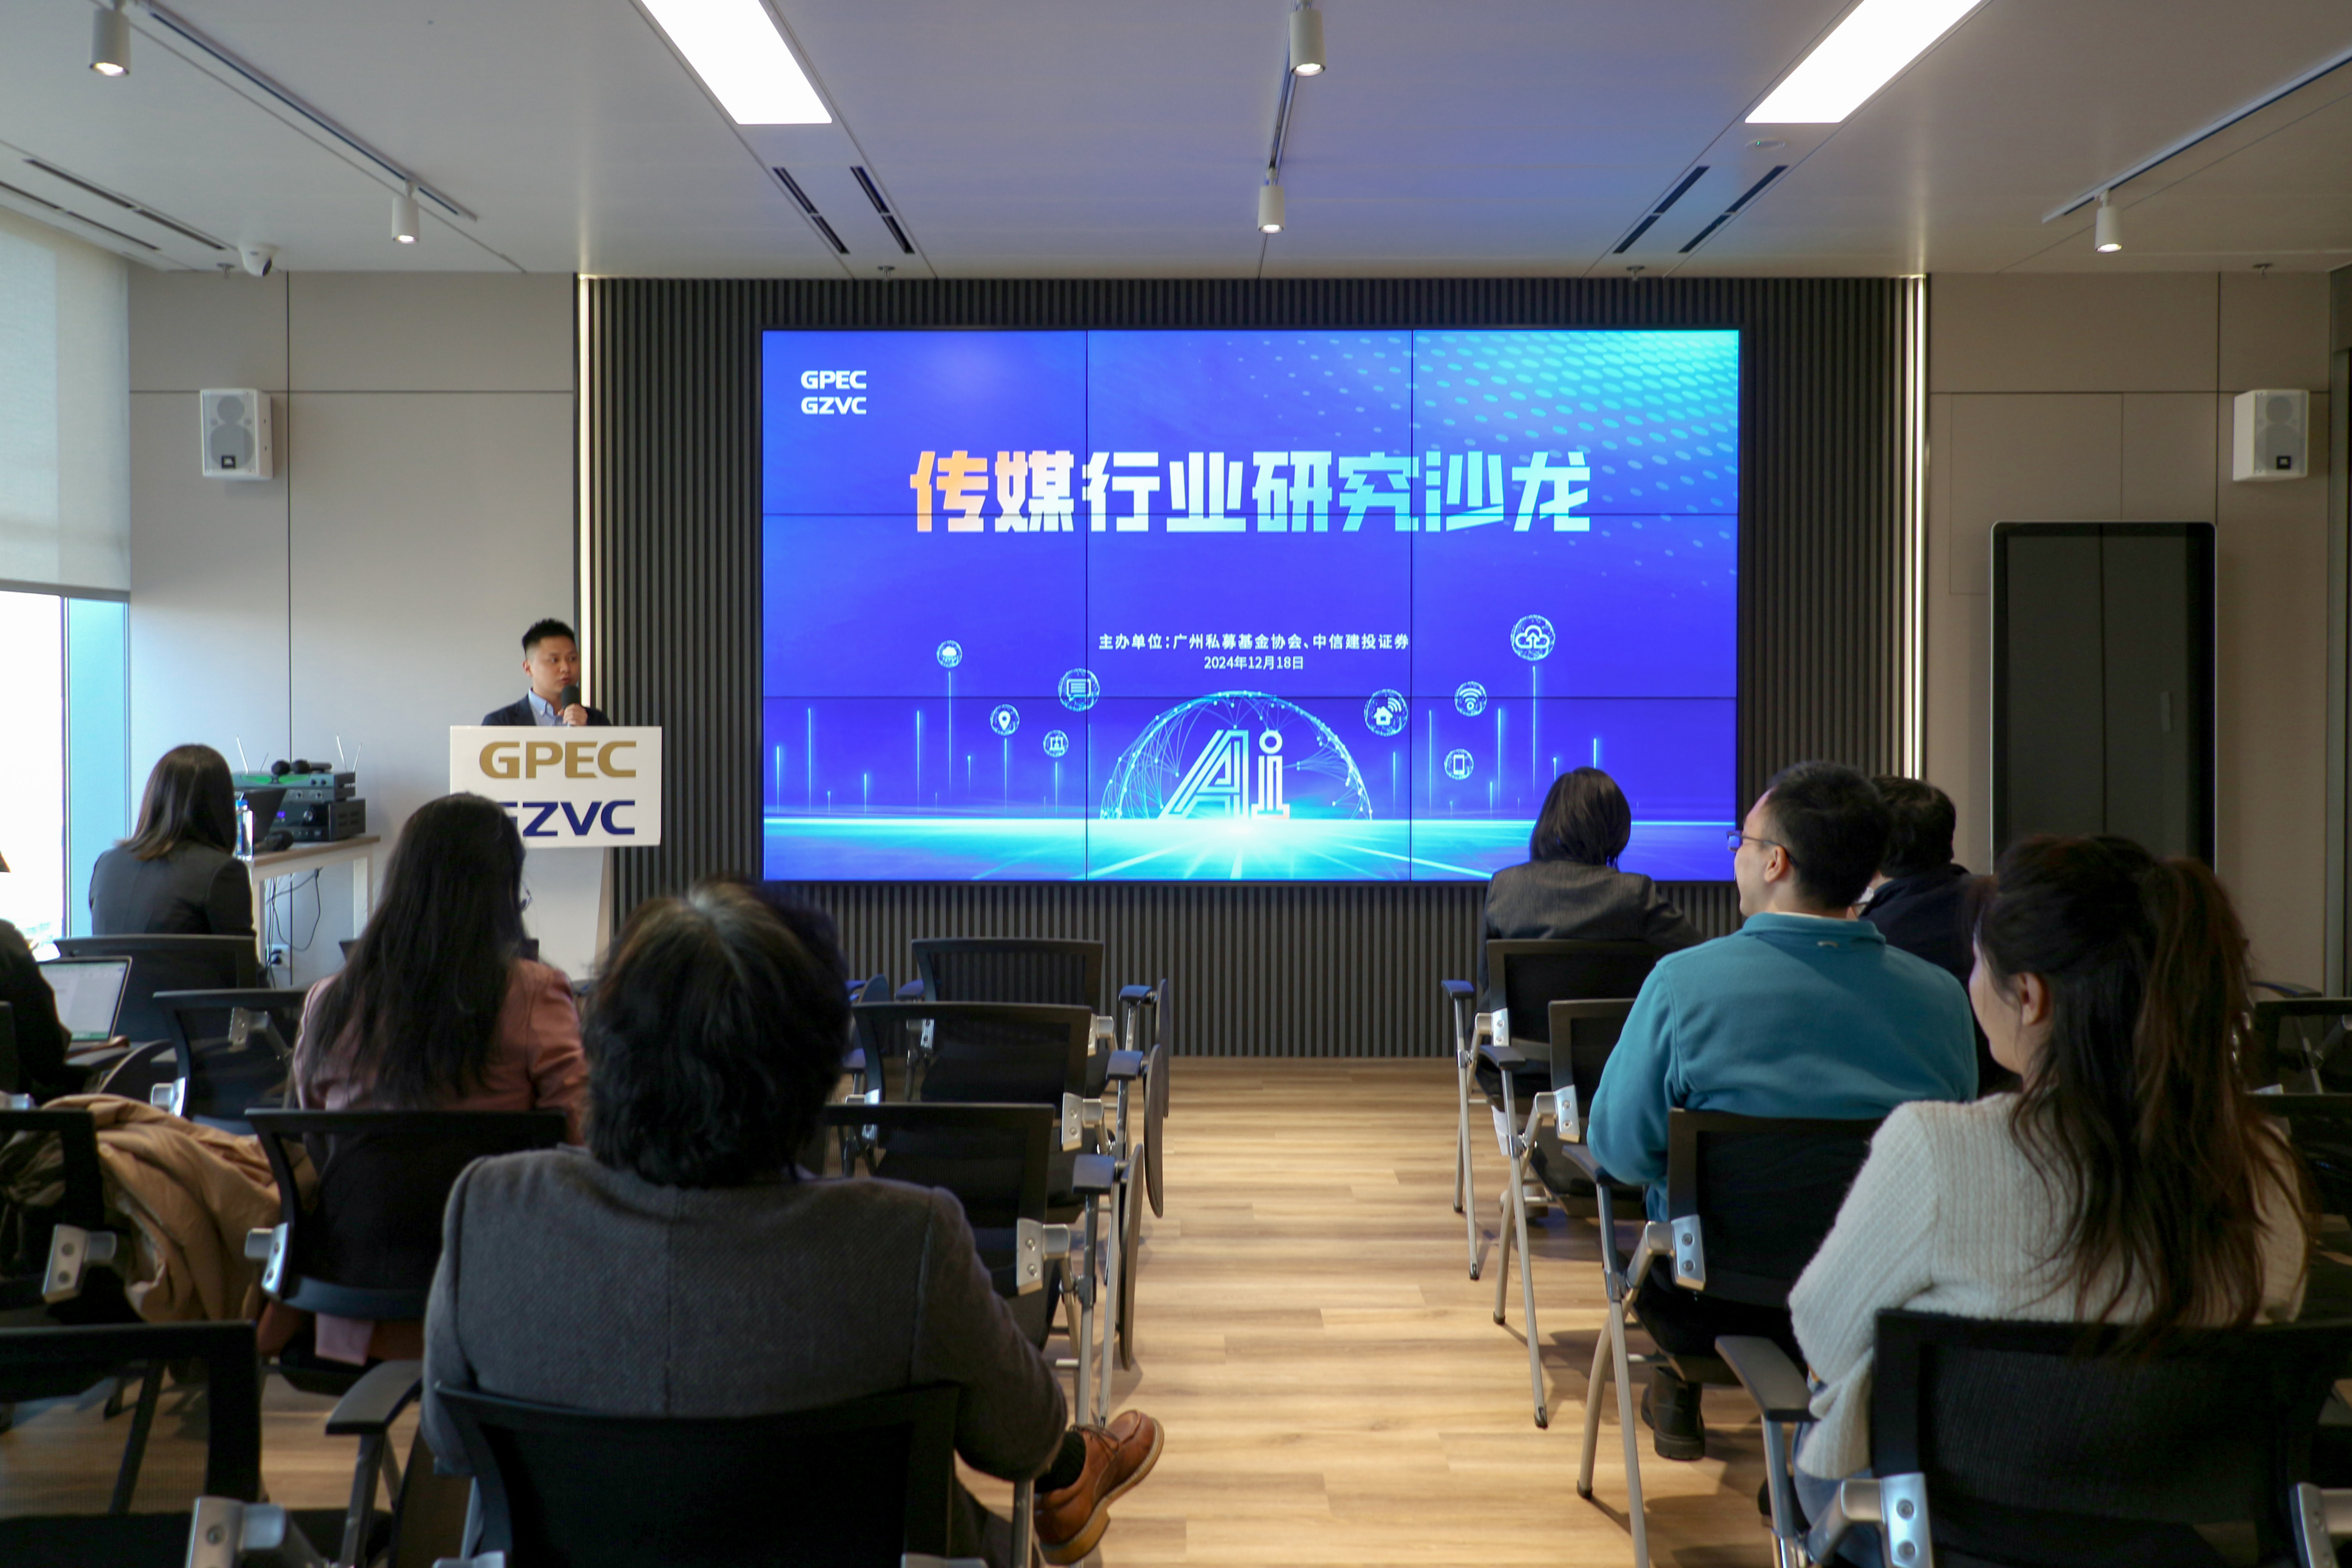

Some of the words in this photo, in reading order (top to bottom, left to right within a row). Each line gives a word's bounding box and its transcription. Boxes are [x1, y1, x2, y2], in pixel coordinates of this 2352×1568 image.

[801, 370, 867, 389] GPEC
[801, 396, 867, 415] GZVC
[910, 450, 1591, 532] 传媒行业研究沙龙
[1204, 655, 1304, 670] 2024年12月18日
[479, 741, 637, 779] GPEC
